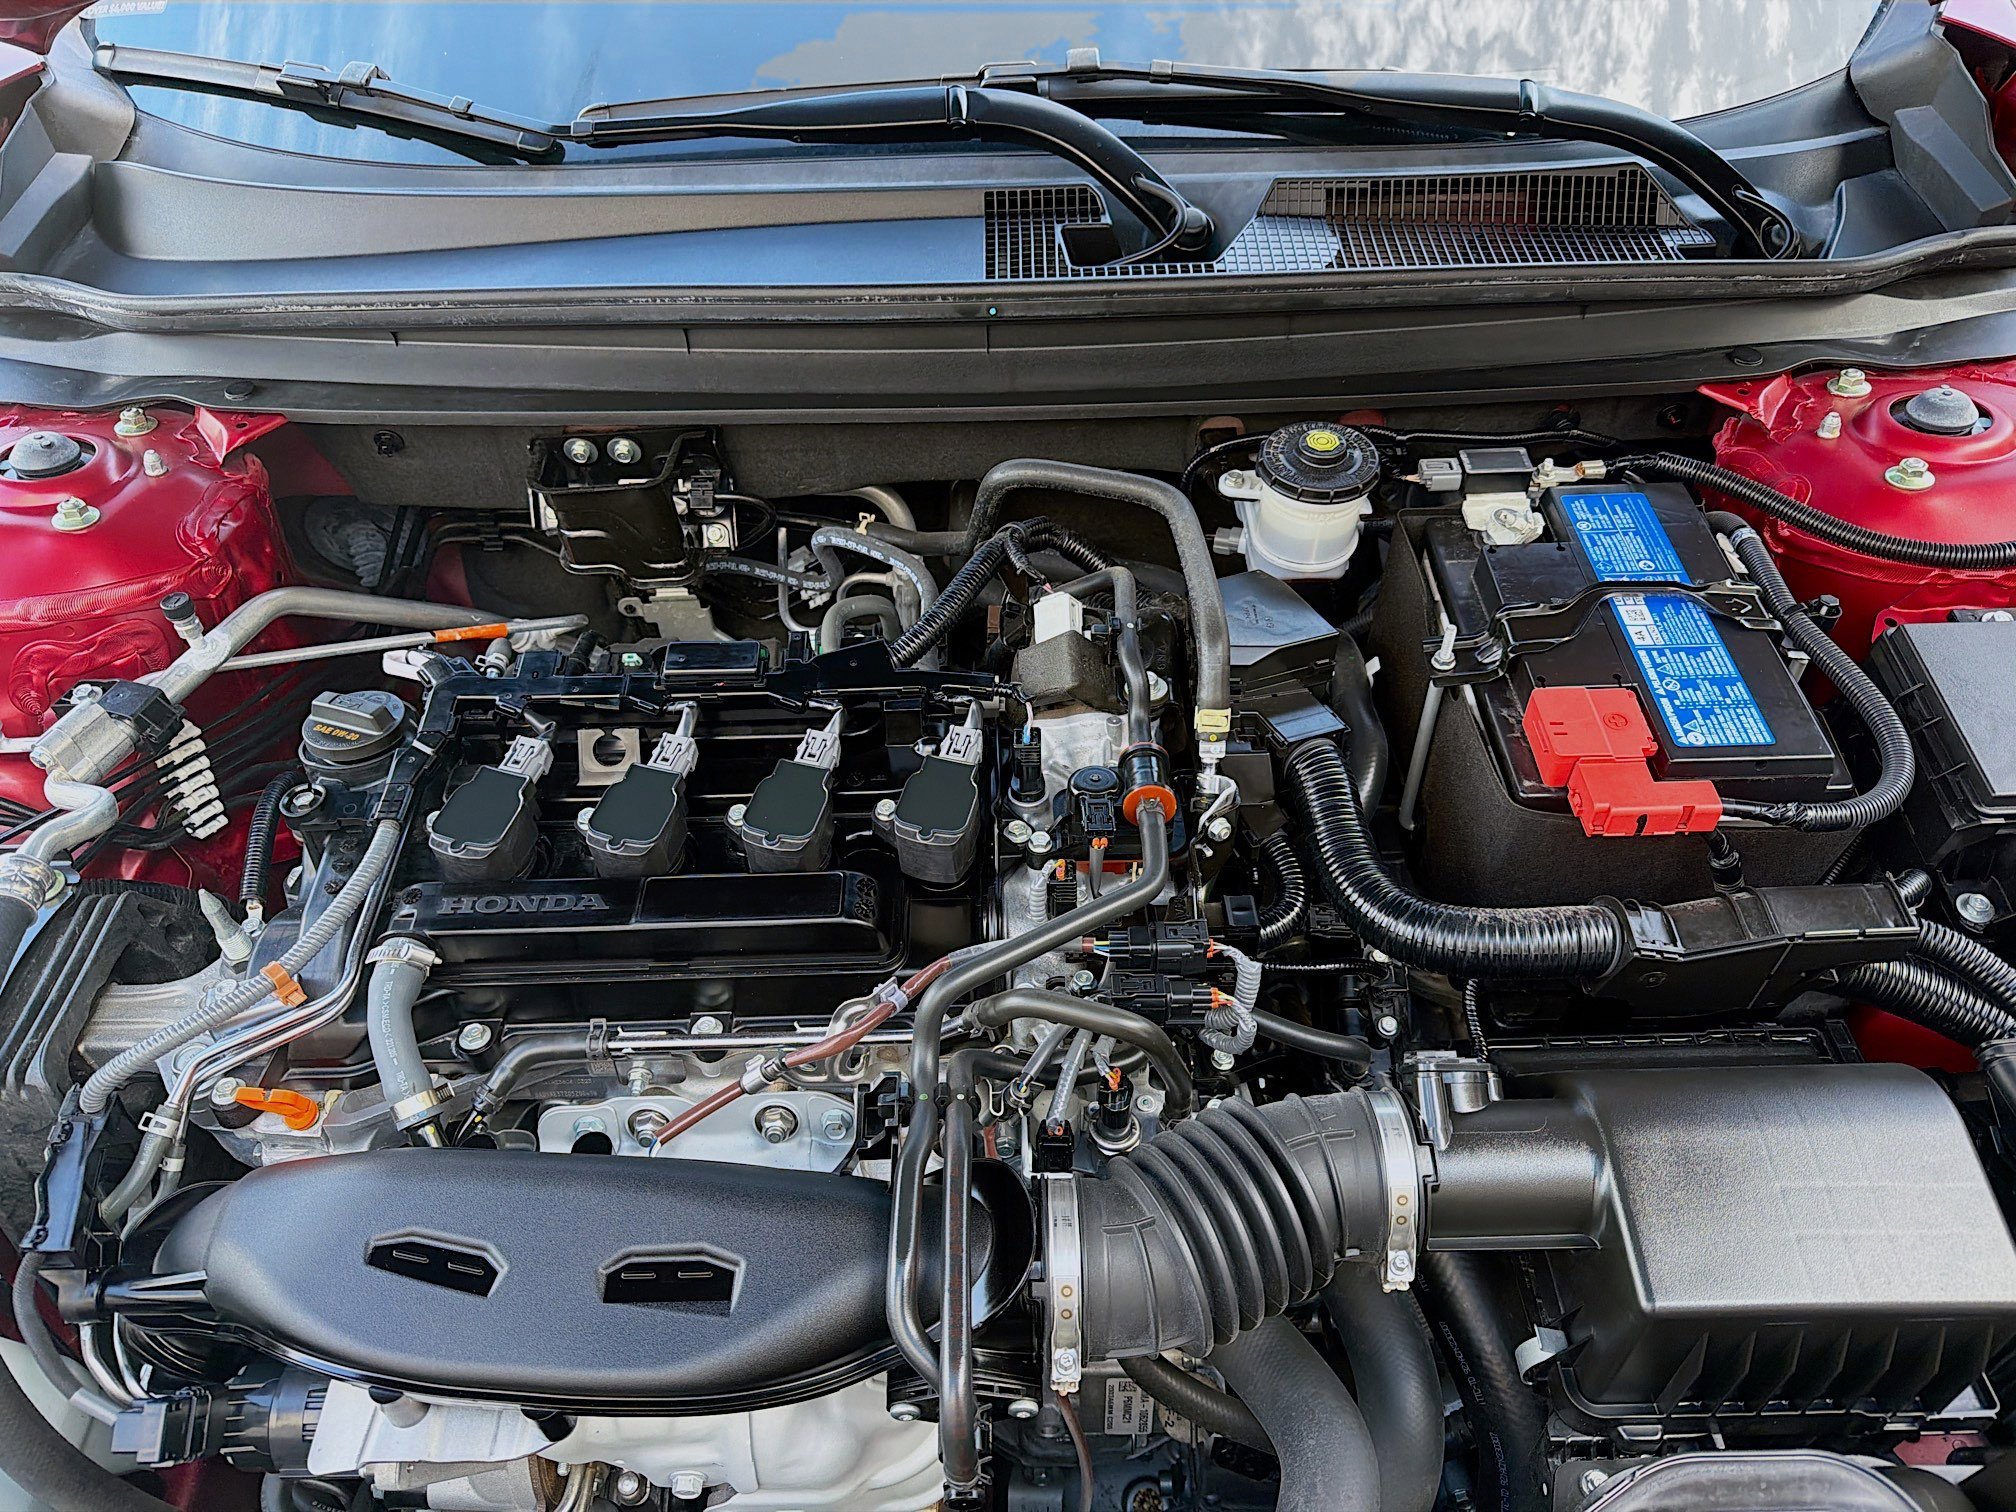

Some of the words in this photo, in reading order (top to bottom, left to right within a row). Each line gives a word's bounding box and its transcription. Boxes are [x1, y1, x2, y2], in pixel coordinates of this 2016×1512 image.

[313, 724, 334, 736] SAE
[332, 728, 360, 741] 0W-20
[437, 893, 610, 915] HONDA
